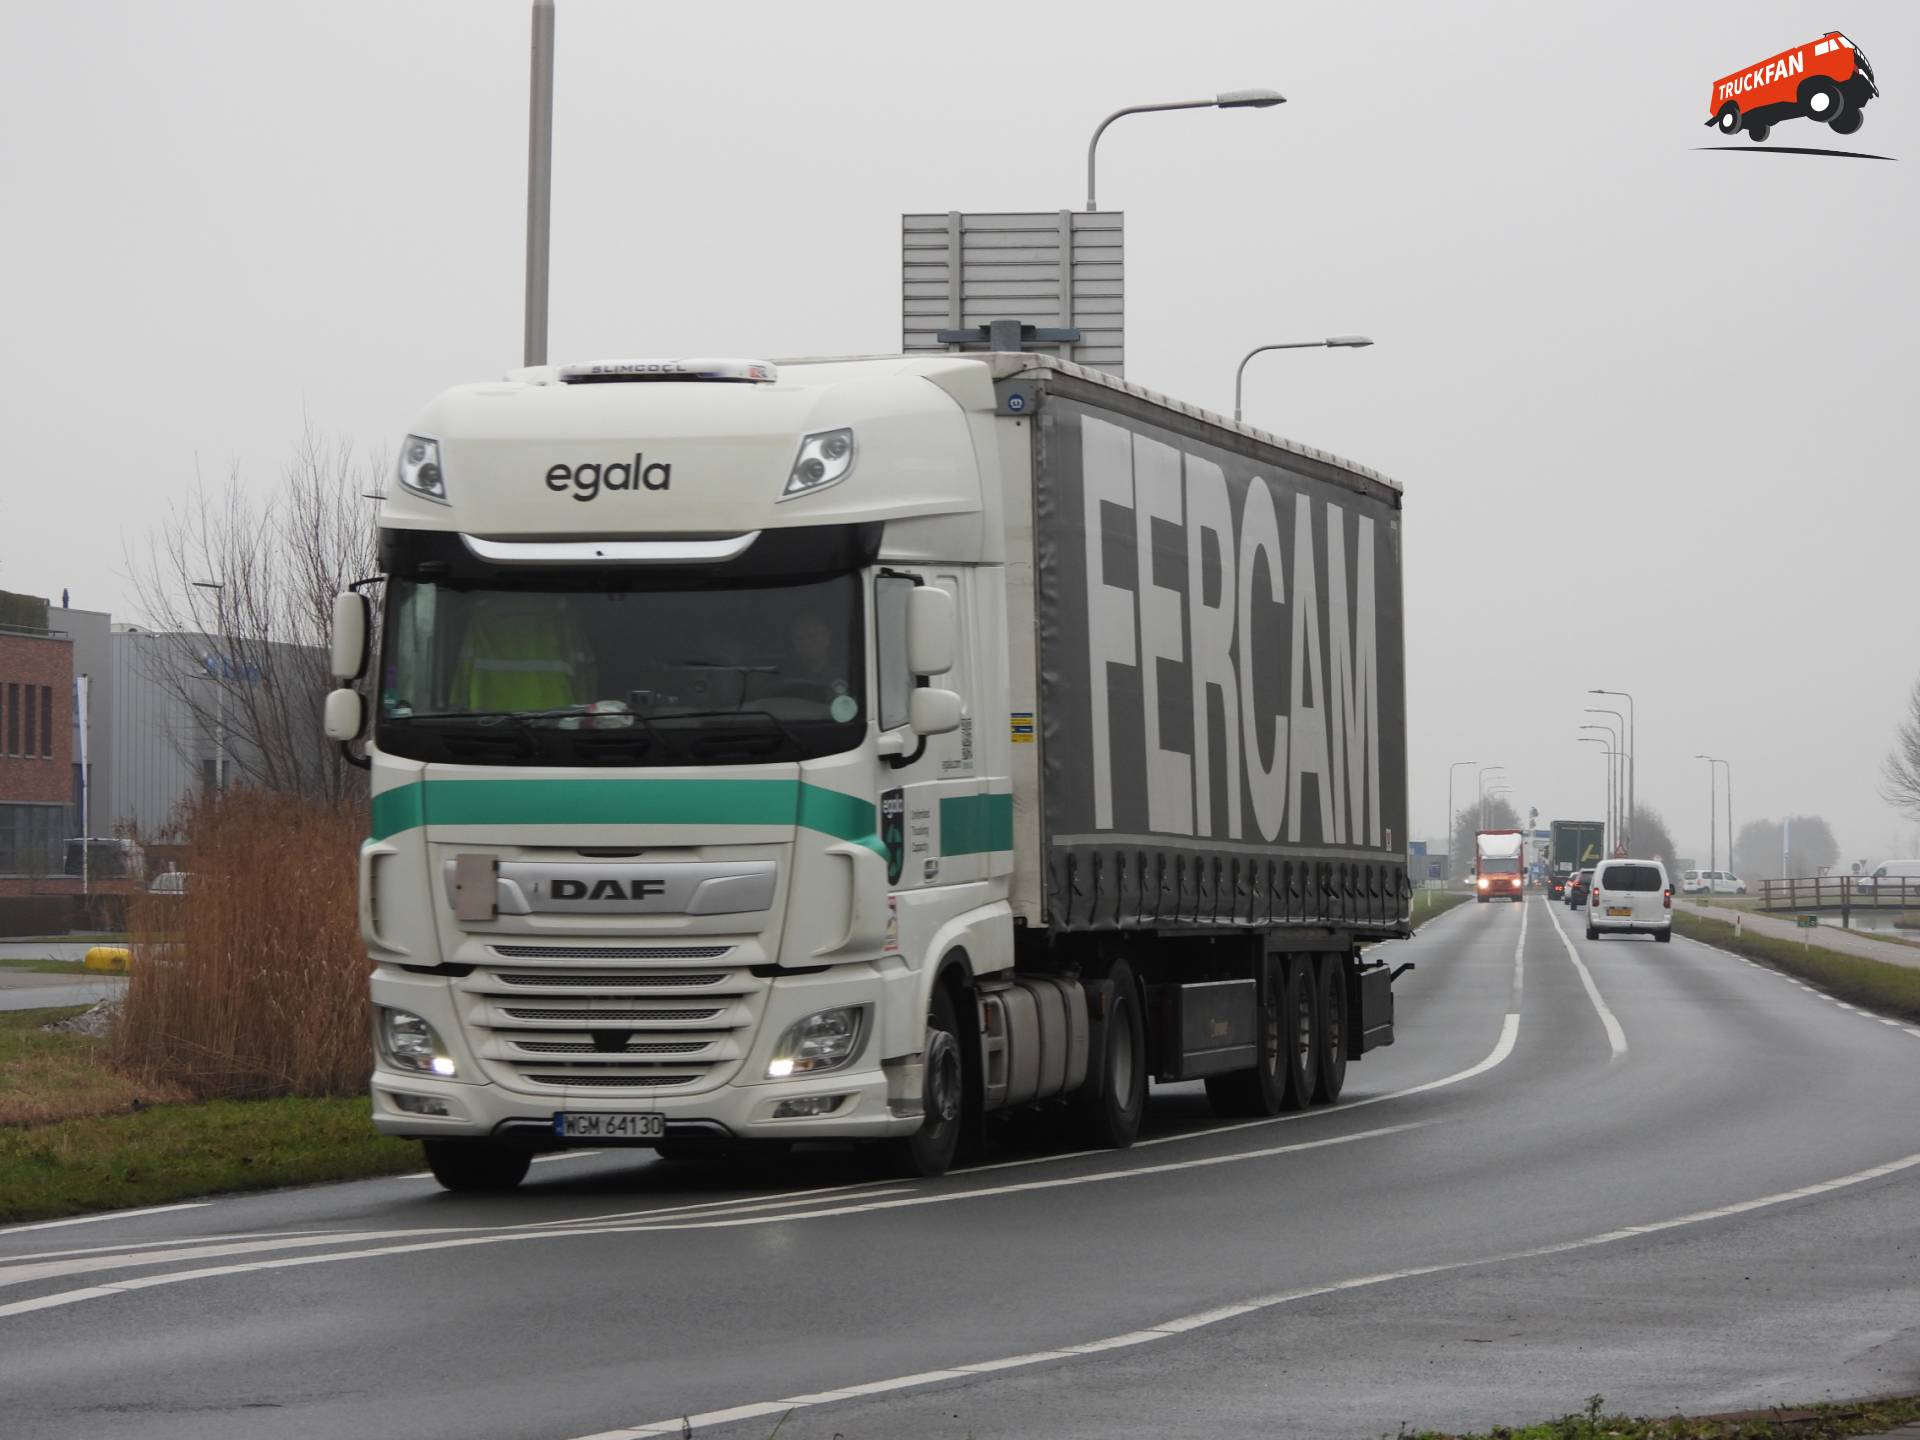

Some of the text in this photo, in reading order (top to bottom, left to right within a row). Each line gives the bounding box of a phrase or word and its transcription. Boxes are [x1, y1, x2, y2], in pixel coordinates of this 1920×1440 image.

[545, 452, 671, 502] egala
[1080, 413, 1381, 847] FERCAM
[551, 879, 666, 900] DAF
[565, 1116, 661, 1135] WGM 64130
